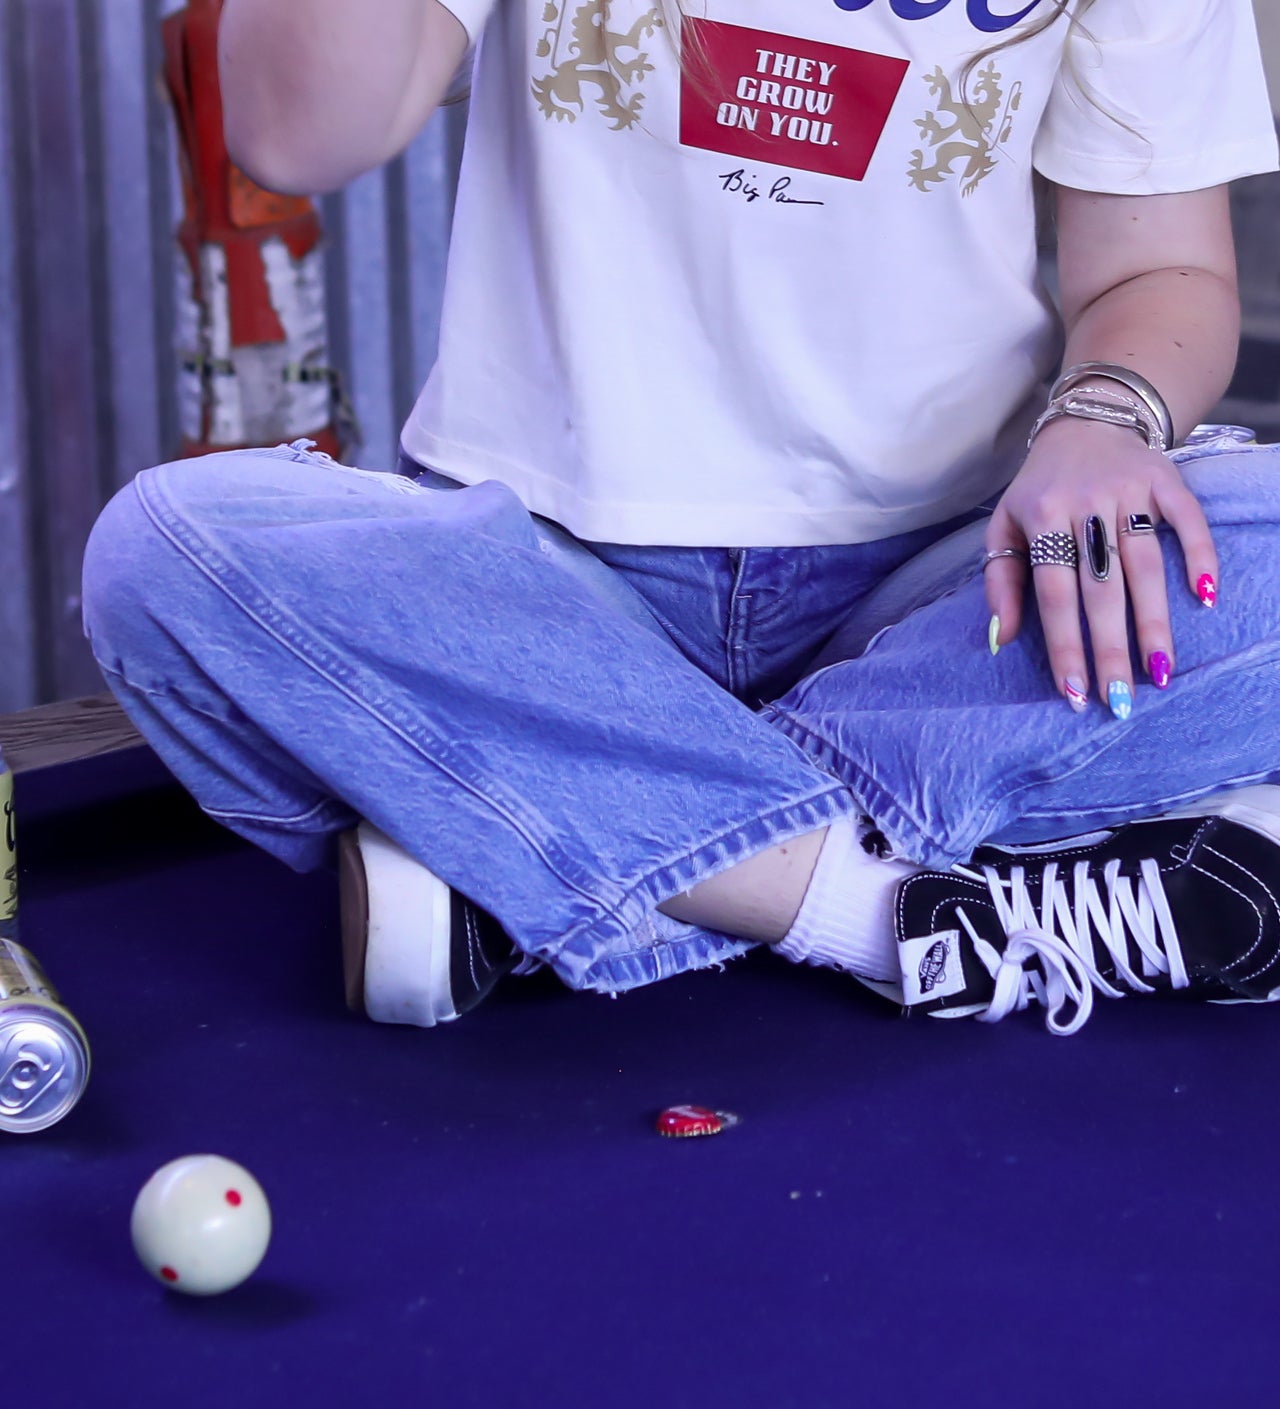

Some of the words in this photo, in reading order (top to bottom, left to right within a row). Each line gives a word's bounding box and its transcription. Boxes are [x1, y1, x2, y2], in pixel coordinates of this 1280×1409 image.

[755, 49, 837, 86] THEY
[736, 76, 834, 115] GROW
[716, 102, 760, 131] ON
[770, 111, 839, 146] YOU.
[719, 169, 760, 202] Big
